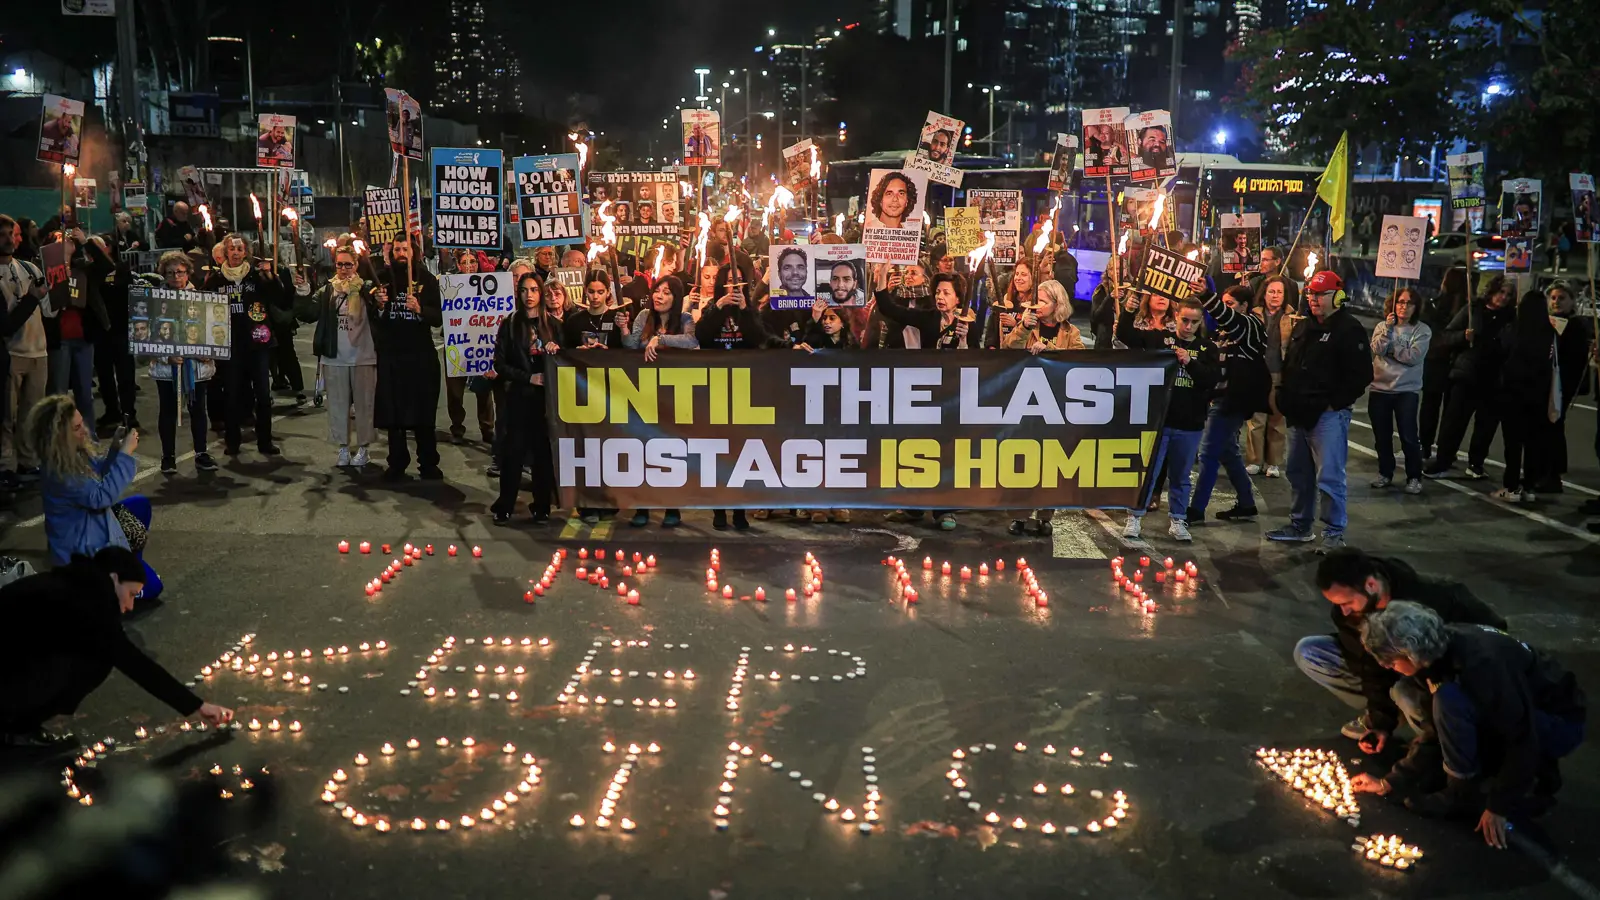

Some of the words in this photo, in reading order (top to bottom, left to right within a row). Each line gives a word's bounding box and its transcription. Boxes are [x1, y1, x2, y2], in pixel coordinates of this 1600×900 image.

[444, 165, 488, 181] HOW
[608, 173, 630, 183] כולם
[631, 172, 652, 182] כולל
[654, 172, 676, 182] כולם
[440, 180, 492, 195] MUCH
[525, 180, 576, 195] BLOW
[1233, 177, 1247, 193] 44
[1284, 180, 1303, 193] מסוף
[365, 188, 400, 202] תוציאו
[366, 199, 401, 215] מעזה
[439, 196, 495, 211] BLOOD
[530, 195, 570, 216] THE
[368, 213, 403, 231] וצאו
[436, 215, 474, 229] WILL
[478, 216, 497, 230] BE
[525, 217, 579, 241] DEAL
[631, 225, 663, 235] החטוף
[664, 225, 678, 234] עד
[437, 230, 498, 245] SPILLED?
[469, 275, 498, 296] 90
[151, 288, 177, 300] כולם
[180, 290, 203, 302] כולל
[204, 293, 228, 304] כולם
[441, 295, 514, 312] HOSTAGES
[778, 299, 798, 308] BRING
[449, 318, 462, 327] IN
[468, 315, 504, 328] GAZA
[447, 333, 470, 346] ALL
[478, 334, 497, 345] MU
[129, 341, 174, 355] האחרון!
[176, 345, 212, 356] החטוף
[213, 347, 229, 357] עד
[464, 347, 496, 359] COM
[557, 367, 776, 425] UNTIL
[790, 367, 942, 424] THE
[960, 367, 1165, 424] LAST
[558, 438, 867, 488] HOSTAGE
[880, 439, 941, 488] IS
[954, 430, 1158, 488] HOME!
[184, 632, 868, 711] KEEP
